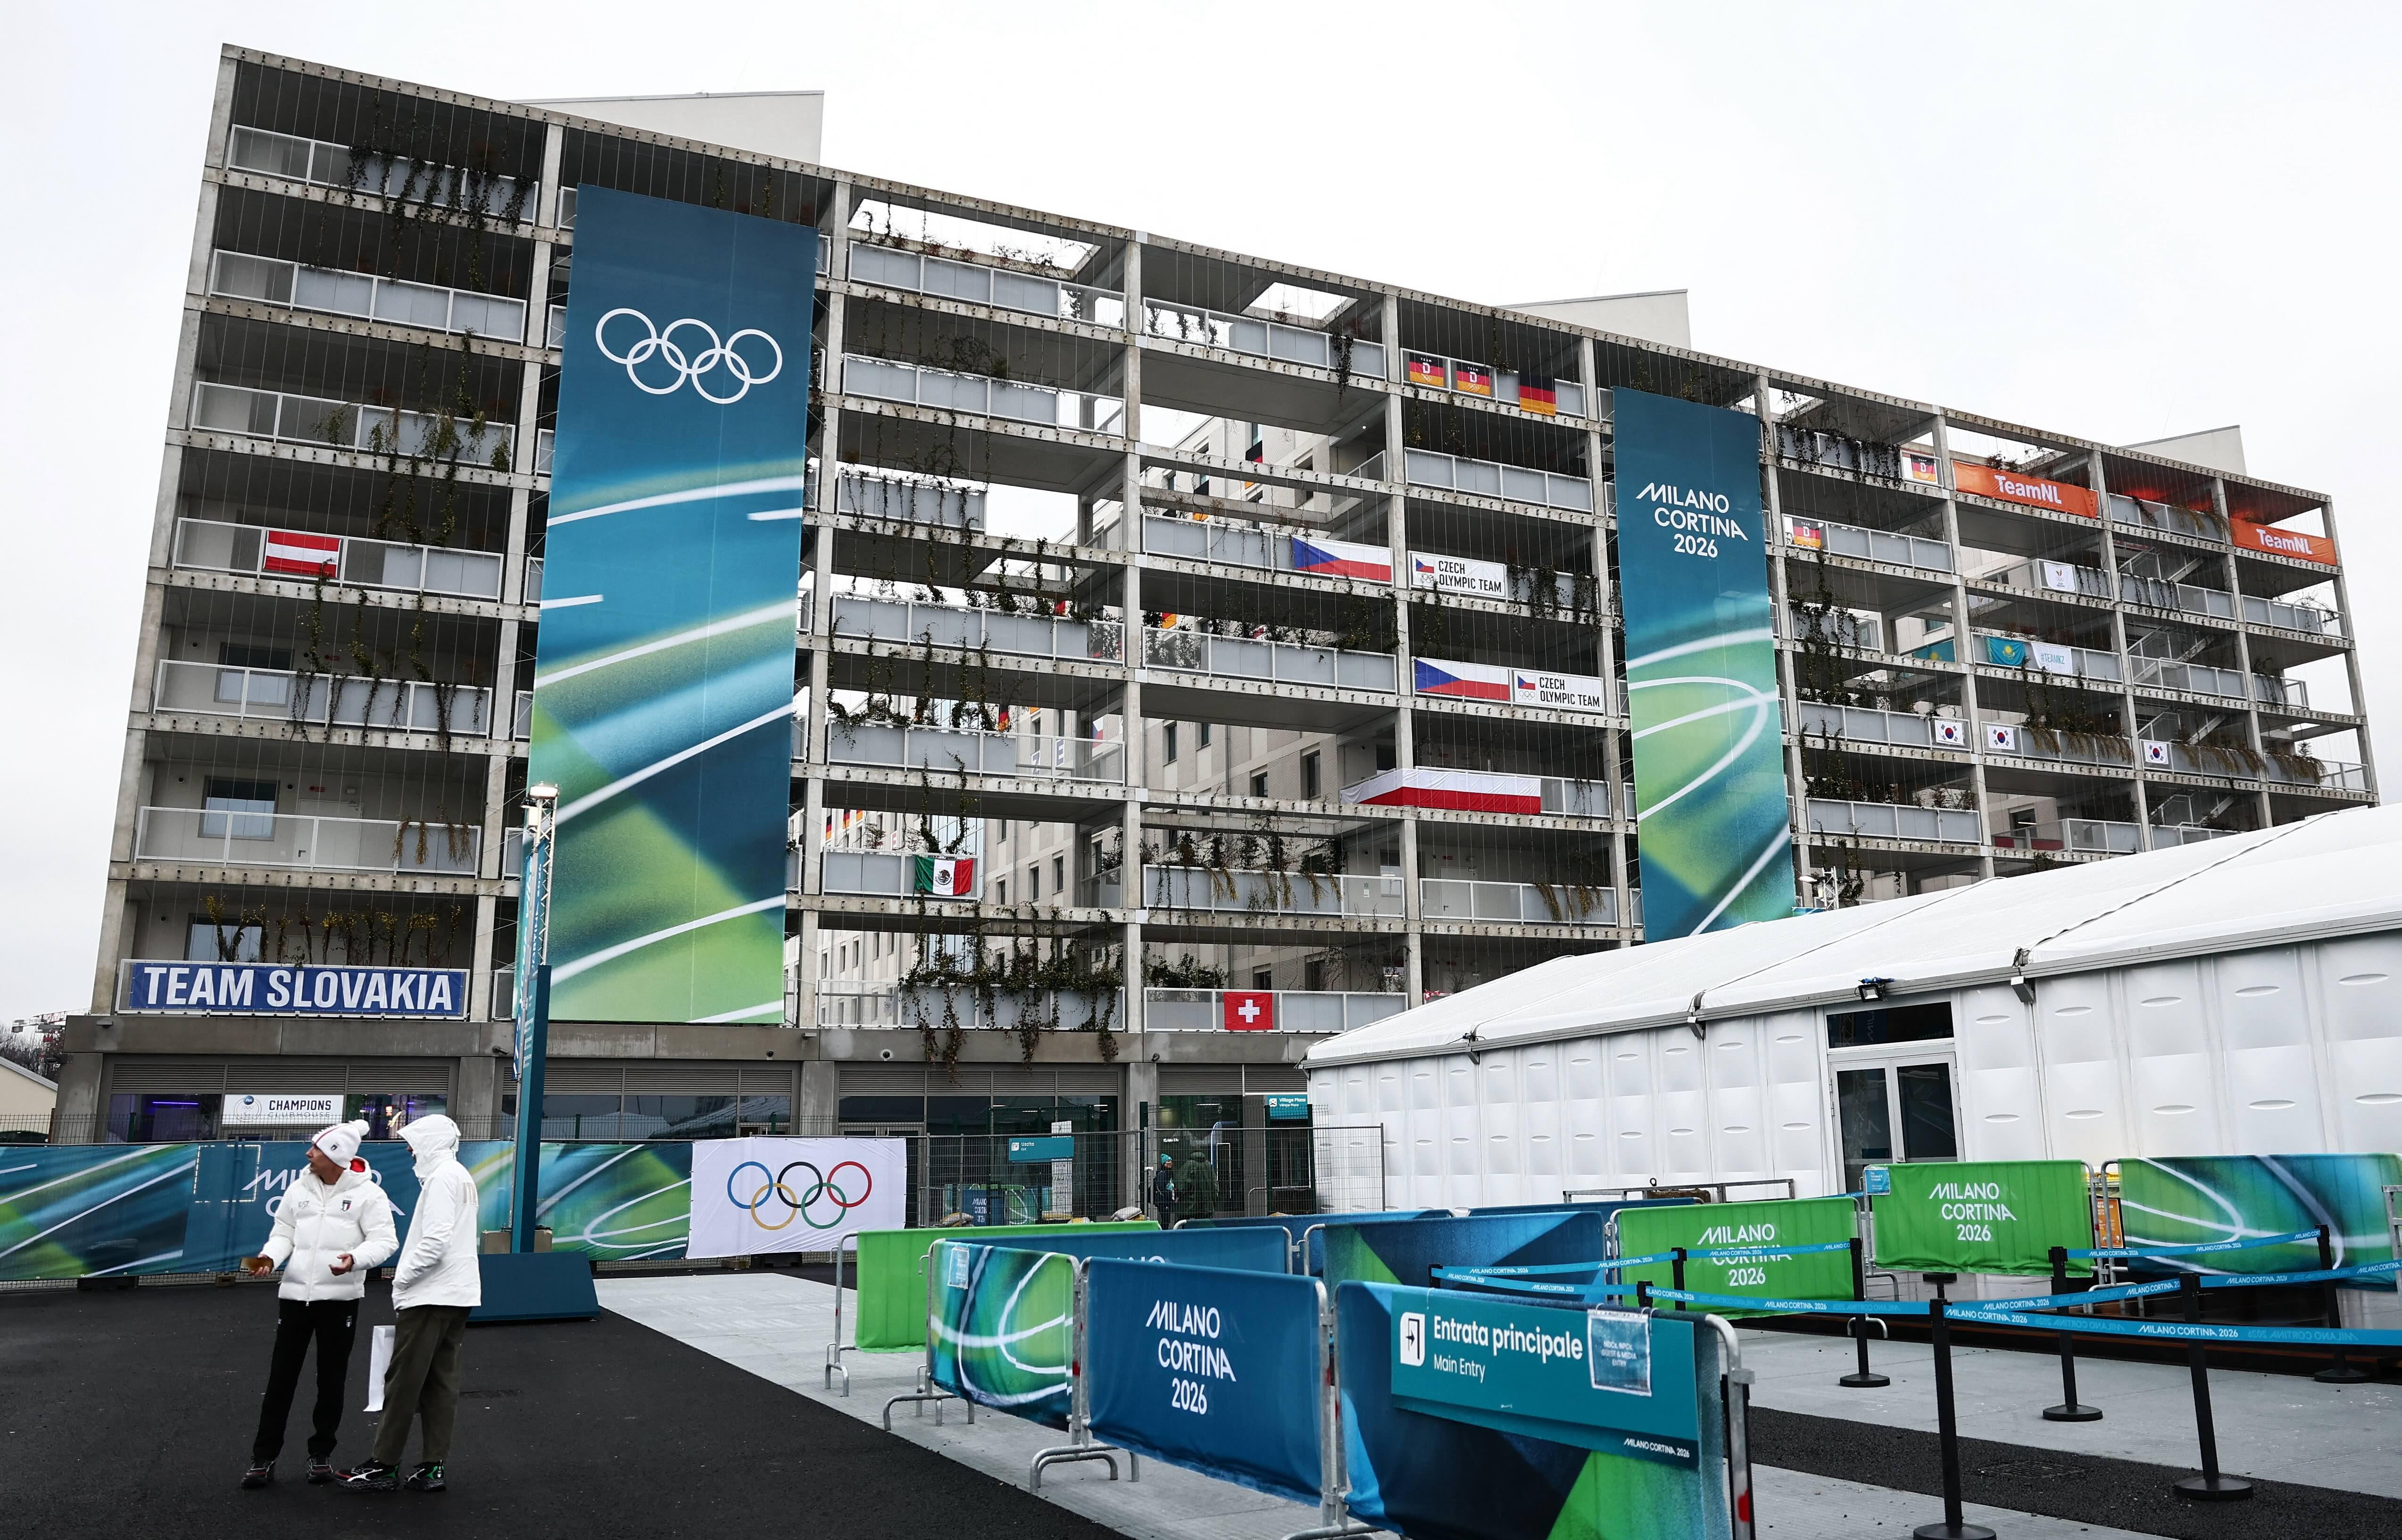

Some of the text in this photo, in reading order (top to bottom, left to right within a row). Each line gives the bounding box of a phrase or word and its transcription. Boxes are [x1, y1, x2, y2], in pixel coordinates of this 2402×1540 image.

[1422, 362, 1430, 374] D
[1470, 371, 1477, 382] D
[1920, 462, 1926, 472] D
[1636, 482, 1729, 514] MILANO
[1994, 475, 2062, 505] TeamNL
[1654, 507, 1749, 541] CORTINA
[1803, 526, 1810, 537] D
[1674, 533, 1718, 558] 2026
[2256, 528, 2313, 555] TeamNL
[1438, 560, 1465, 575] CZECH
[1439, 574, 1502, 593] OLYMPIC TEAM
[2041, 653, 2065, 664] #TEAMKZ
[1539, 677, 1565, 690] CZECH
[1540, 690, 1600, 707] OLYMPIC TEAM
[143, 966, 453, 1011] TEAM SLOVAKIA
[269, 1100, 332, 1111] CHAMPIONS
[1928, 1182, 2000, 1200] MILANO
[1941, 1203, 2017, 1221] CORTINA
[1697, 1224, 1775, 1245] MILANO
[1957, 1224, 1991, 1242] 2026
[2311, 1229, 2320, 1237] CORT
[1598, 1260, 1619, 1268] MILANO
[2357, 1262, 2400, 1274] MILANO CORTINA
[1729, 1267, 1766, 1286] 2026
[1662, 1288, 1683, 1299] CORTINA
[2126, 1286, 2150, 1296] MILANO
[2150, 1283, 2173, 1292] CORTINA
[1789, 1301, 1814, 1309] CORTINA
[1983, 1299, 2049, 1310] MILANO CORTINA 2026
[1146, 1300, 1220, 1339] MILANO
[1946, 1308, 2028, 1324] MILANO CORTINA 2026
[2139, 1325, 2238, 1337] MILANO CORTINA 2026
[1434, 1315, 1583, 1364] Entrata principale
[1158, 1338, 1237, 1382] CORTINA
[1612, 1359, 1627, 1367] ENTRY
[1621, 1351, 1637, 1360] MEDIA
[1434, 1353, 1485, 1383] Main Entry
[1172, 1377, 1207, 1415] 2026
[1624, 1438, 1690, 1458] MILANO CORTINA 2026
